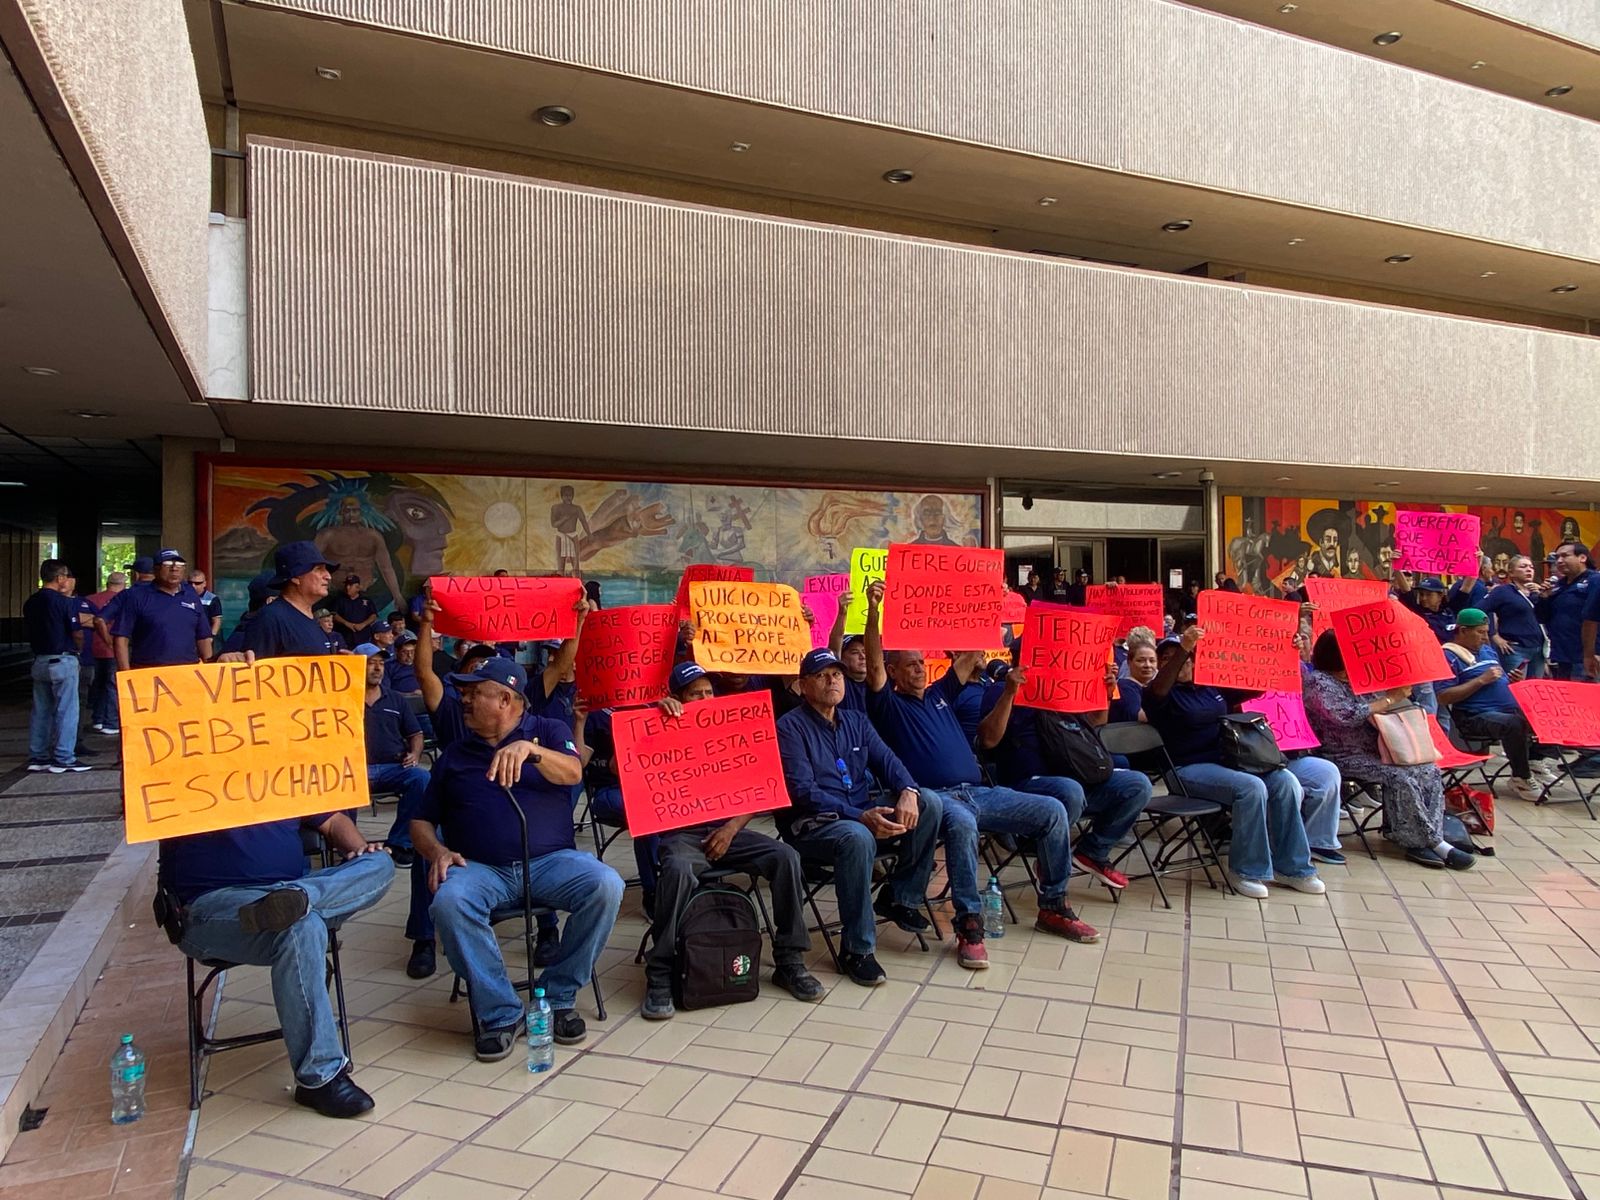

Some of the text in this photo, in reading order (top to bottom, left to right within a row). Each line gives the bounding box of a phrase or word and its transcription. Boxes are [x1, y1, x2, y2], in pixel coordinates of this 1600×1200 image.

[1398, 514, 1474, 533] QUEREMOS
[1397, 531, 1459, 546] QUE LA
[899, 550, 1001, 574] TERE GUERRA
[1401, 545, 1472, 563] FISCALIA
[1402, 558, 1457, 574] ACTUE
[695, 587, 760, 608] JUICIO
[769, 591, 792, 608] DE
[890, 582, 953, 600] ¿DONDE
[964, 584, 996, 598] ESTA
[484, 594, 517, 612] DE
[903, 603, 924, 615] EL
[931, 600, 1002, 616] PRESUPUESTO
[1204, 594, 1244, 617] TERE
[452, 608, 558, 635] SINALOA
[588, 613, 622, 631] ERE
[695, 610, 801, 632] PROCEDENCIA
[900, 617, 924, 630] QUE
[1034, 613, 1091, 646] TERE
[639, 630, 662, 646] DE
[702, 629, 786, 646] AL PROFE
[584, 649, 669, 674] PROTEGER
[1199, 650, 1206, 659] A
[616, 667, 641, 682] UN
[1210, 672, 1281, 690] IMPUNE
[127, 661, 351, 713] LA VERDAD
[1520, 684, 1576, 704] TERE
[624, 702, 771, 742] TERE GUERRA
[1276, 702, 1290, 722] A
[142, 708, 354, 766] DEBE SER
[623, 729, 775, 773] ¿DONDE ESTA EL
[644, 752, 757, 791] PRESUPUESTO
[141, 756, 356, 824] ESCUCHADA
[652, 784, 691, 805] QUE
[654, 777, 778, 822] PROMETISTE?
